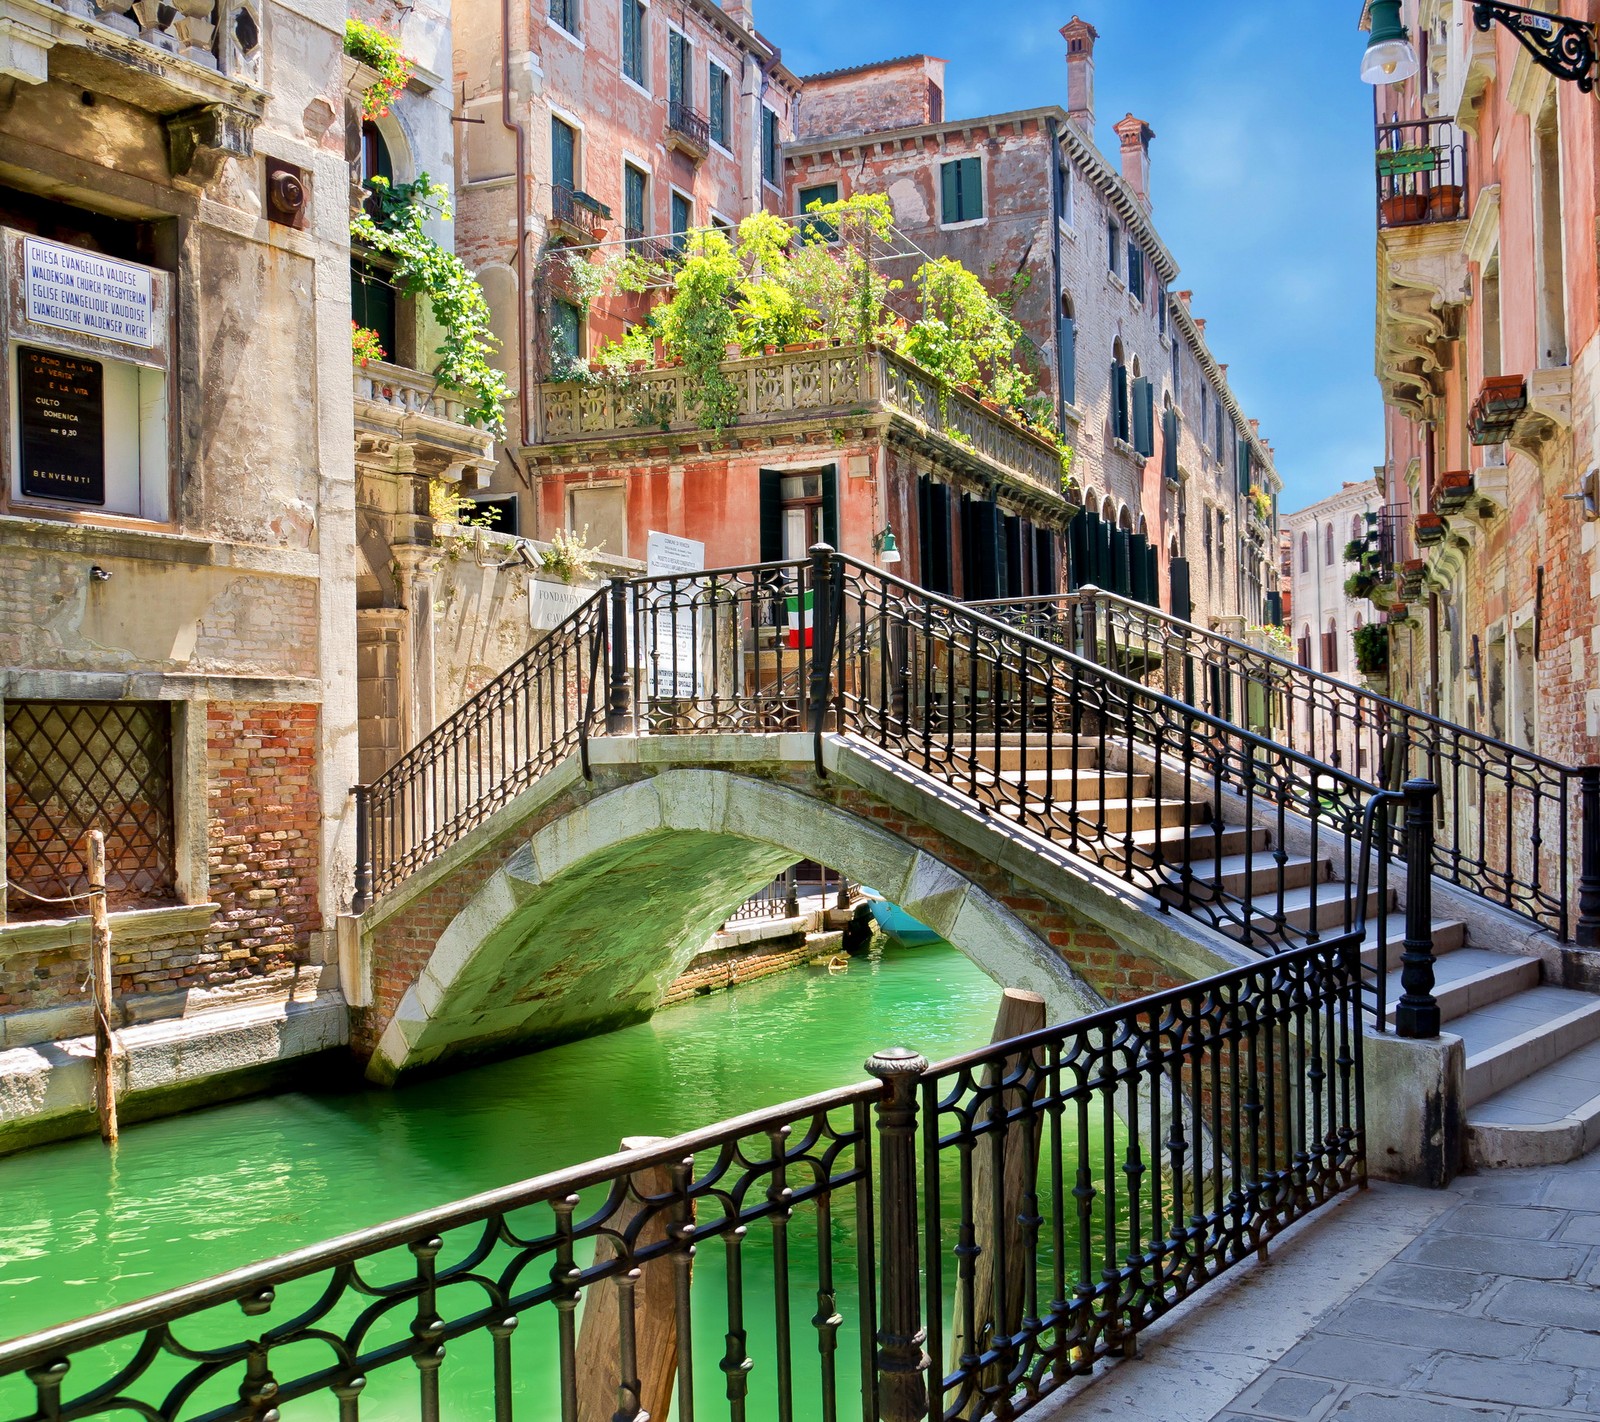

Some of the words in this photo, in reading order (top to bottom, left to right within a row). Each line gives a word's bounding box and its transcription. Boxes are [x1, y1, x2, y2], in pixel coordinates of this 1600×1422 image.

[1523, 15, 1532, 24] CS
[32, 248, 58, 265] CHIESA
[62, 255, 104, 277] EVANGELICA
[106, 267, 136, 286] VALDESE
[32, 266, 74, 287] WALDENSIAN
[77, 277, 101, 294] CHURCH
[104, 284, 146, 305] PRESBYTERIAN
[33, 284, 58, 301] EGLISE
[62, 291, 108, 313] EVANGELIQUE
[111, 303, 145, 322] VAUDOISE
[34, 301, 81, 324] EVANGELISCHE
[84, 313, 123, 333] WALDENSER
[126, 324, 147, 339] KIRCHE
[66, 361, 76, 369] LA
[82, 365, 94, 373] VIA
[74, 388, 89, 396] VITA
[36, 397, 60, 407] CULTO
[44, 410, 79, 422] DOMENICA
[33, 470, 90, 484] BENVENUTI
